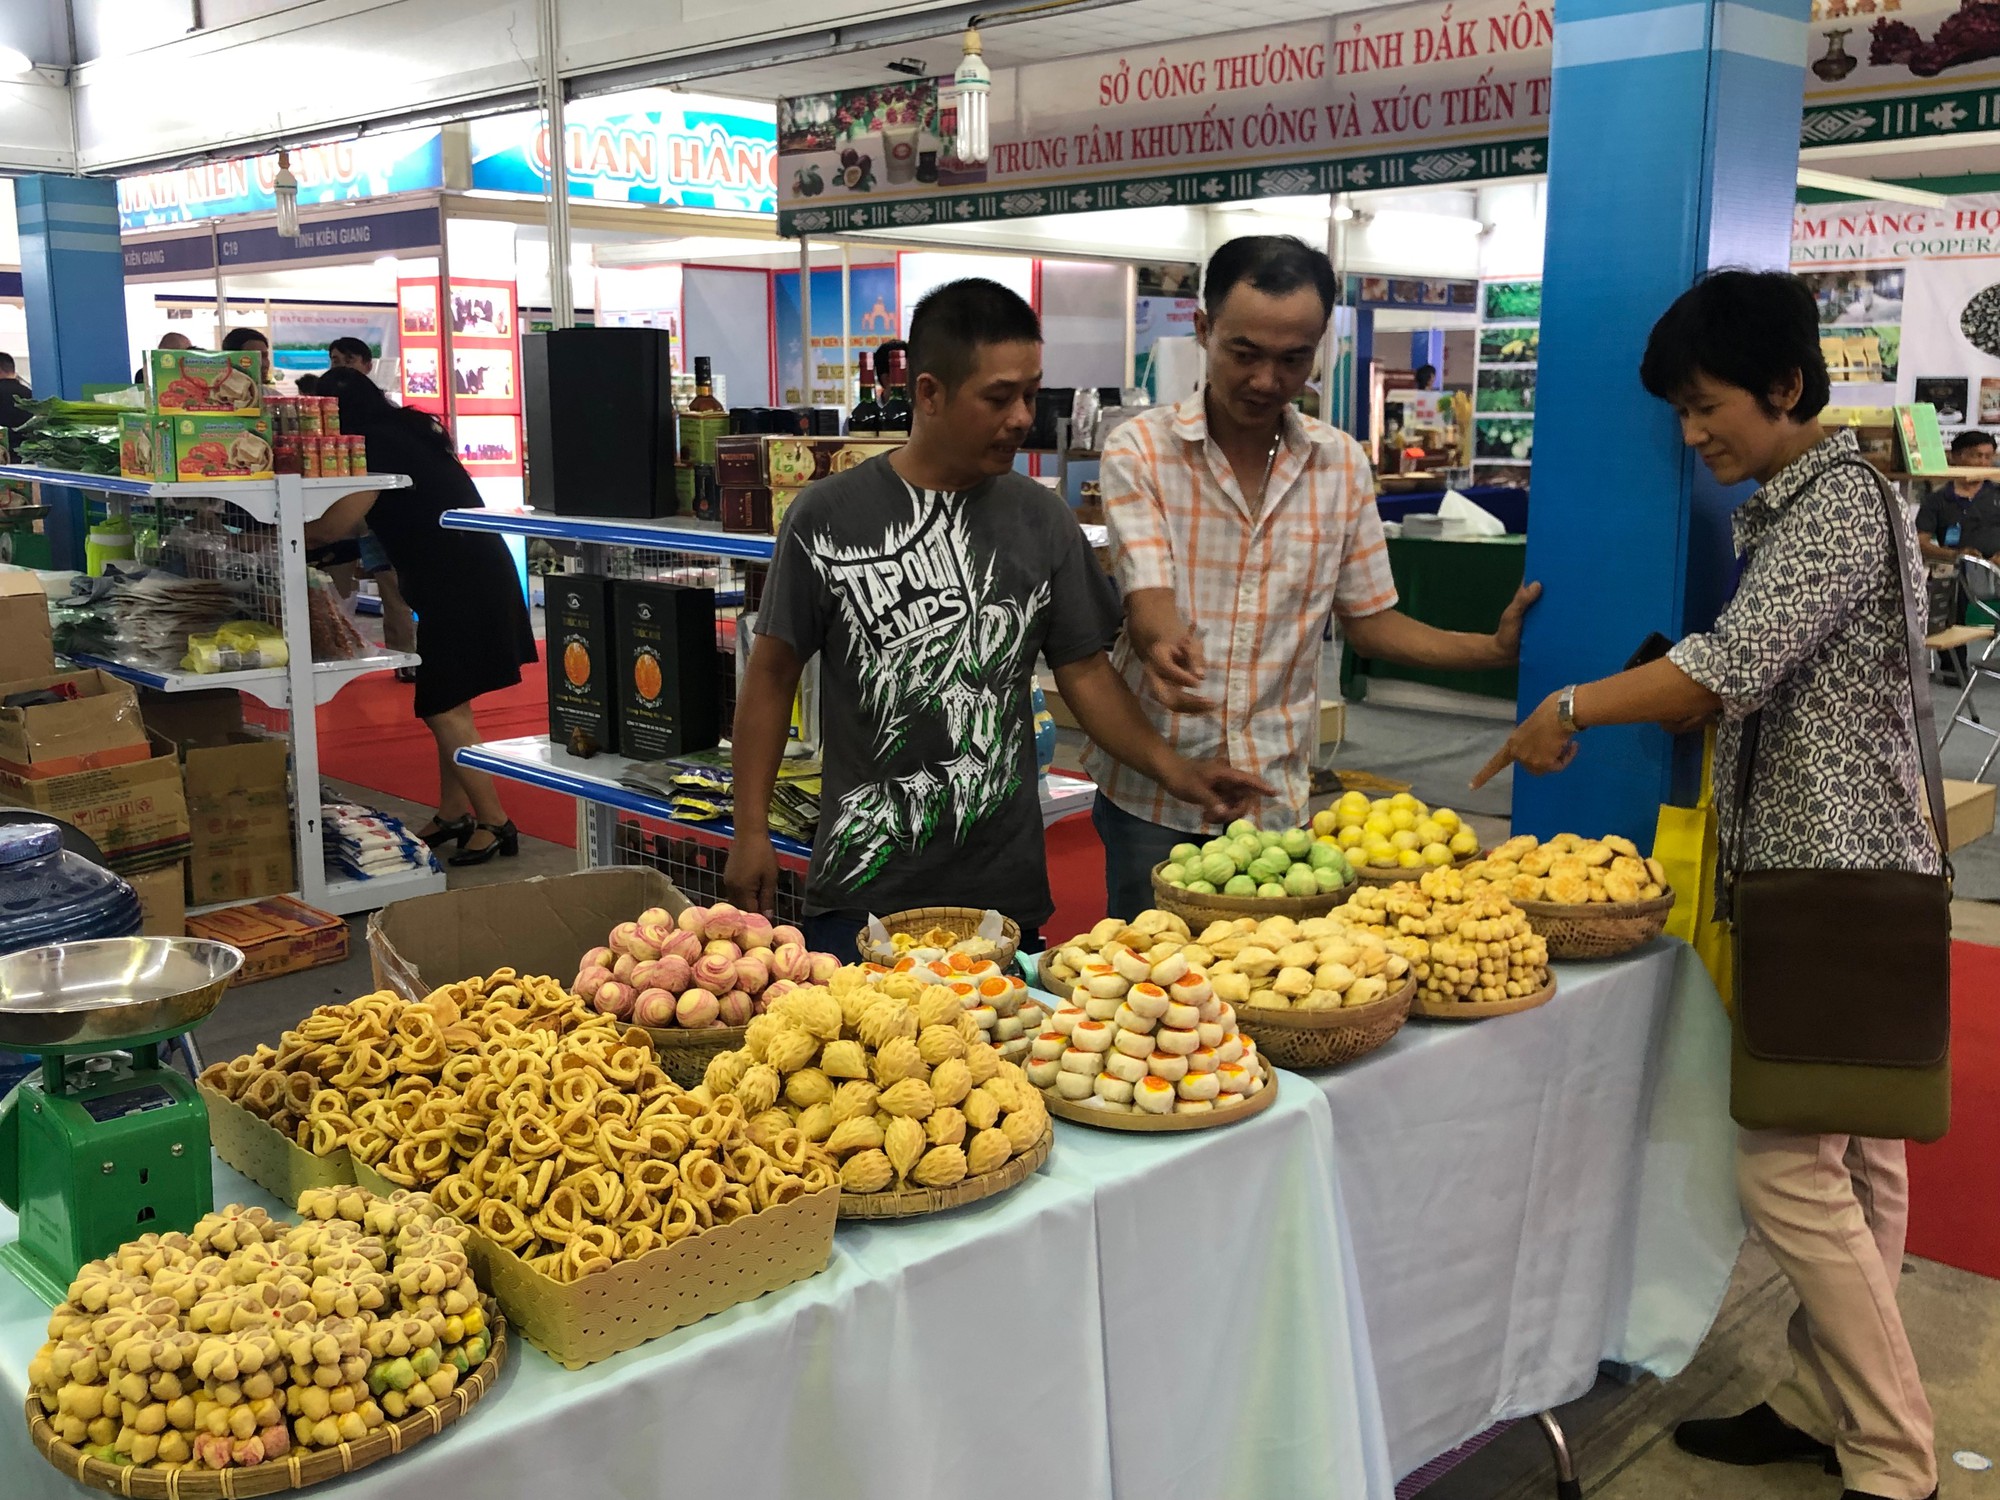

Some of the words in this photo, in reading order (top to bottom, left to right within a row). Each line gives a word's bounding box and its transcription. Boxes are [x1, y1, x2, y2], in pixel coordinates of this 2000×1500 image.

[1099, 58, 1131, 106] SỞ
[1137, 56, 1206, 101] CÔNG
[1214, 43, 1325, 91] THƯƠNG
[1334, 23, 1404, 76] TỈNH
[1413, 4, 1478, 64] ĐẮK
[993, 137, 1067, 174] TRUNG
[1074, 123, 1124, 166] TÂM
[1131, 103, 1235, 160] KHUYẾN
[1242, 103, 1317, 148] CÔNG
[1325, 92, 1362, 140] VÀ
[1371, 84, 1431, 135] XÚC
[1440, 66, 1517, 127] TIẾN
[316, 227, 338, 247] KIÊN
[339, 226, 371, 244] GIANG
[1838, 206, 1926, 239] NĂNG
[223, 241, 238, 256] C19
[831, 509, 962, 627] TAPOUT
[890, 587, 968, 636] MPS
